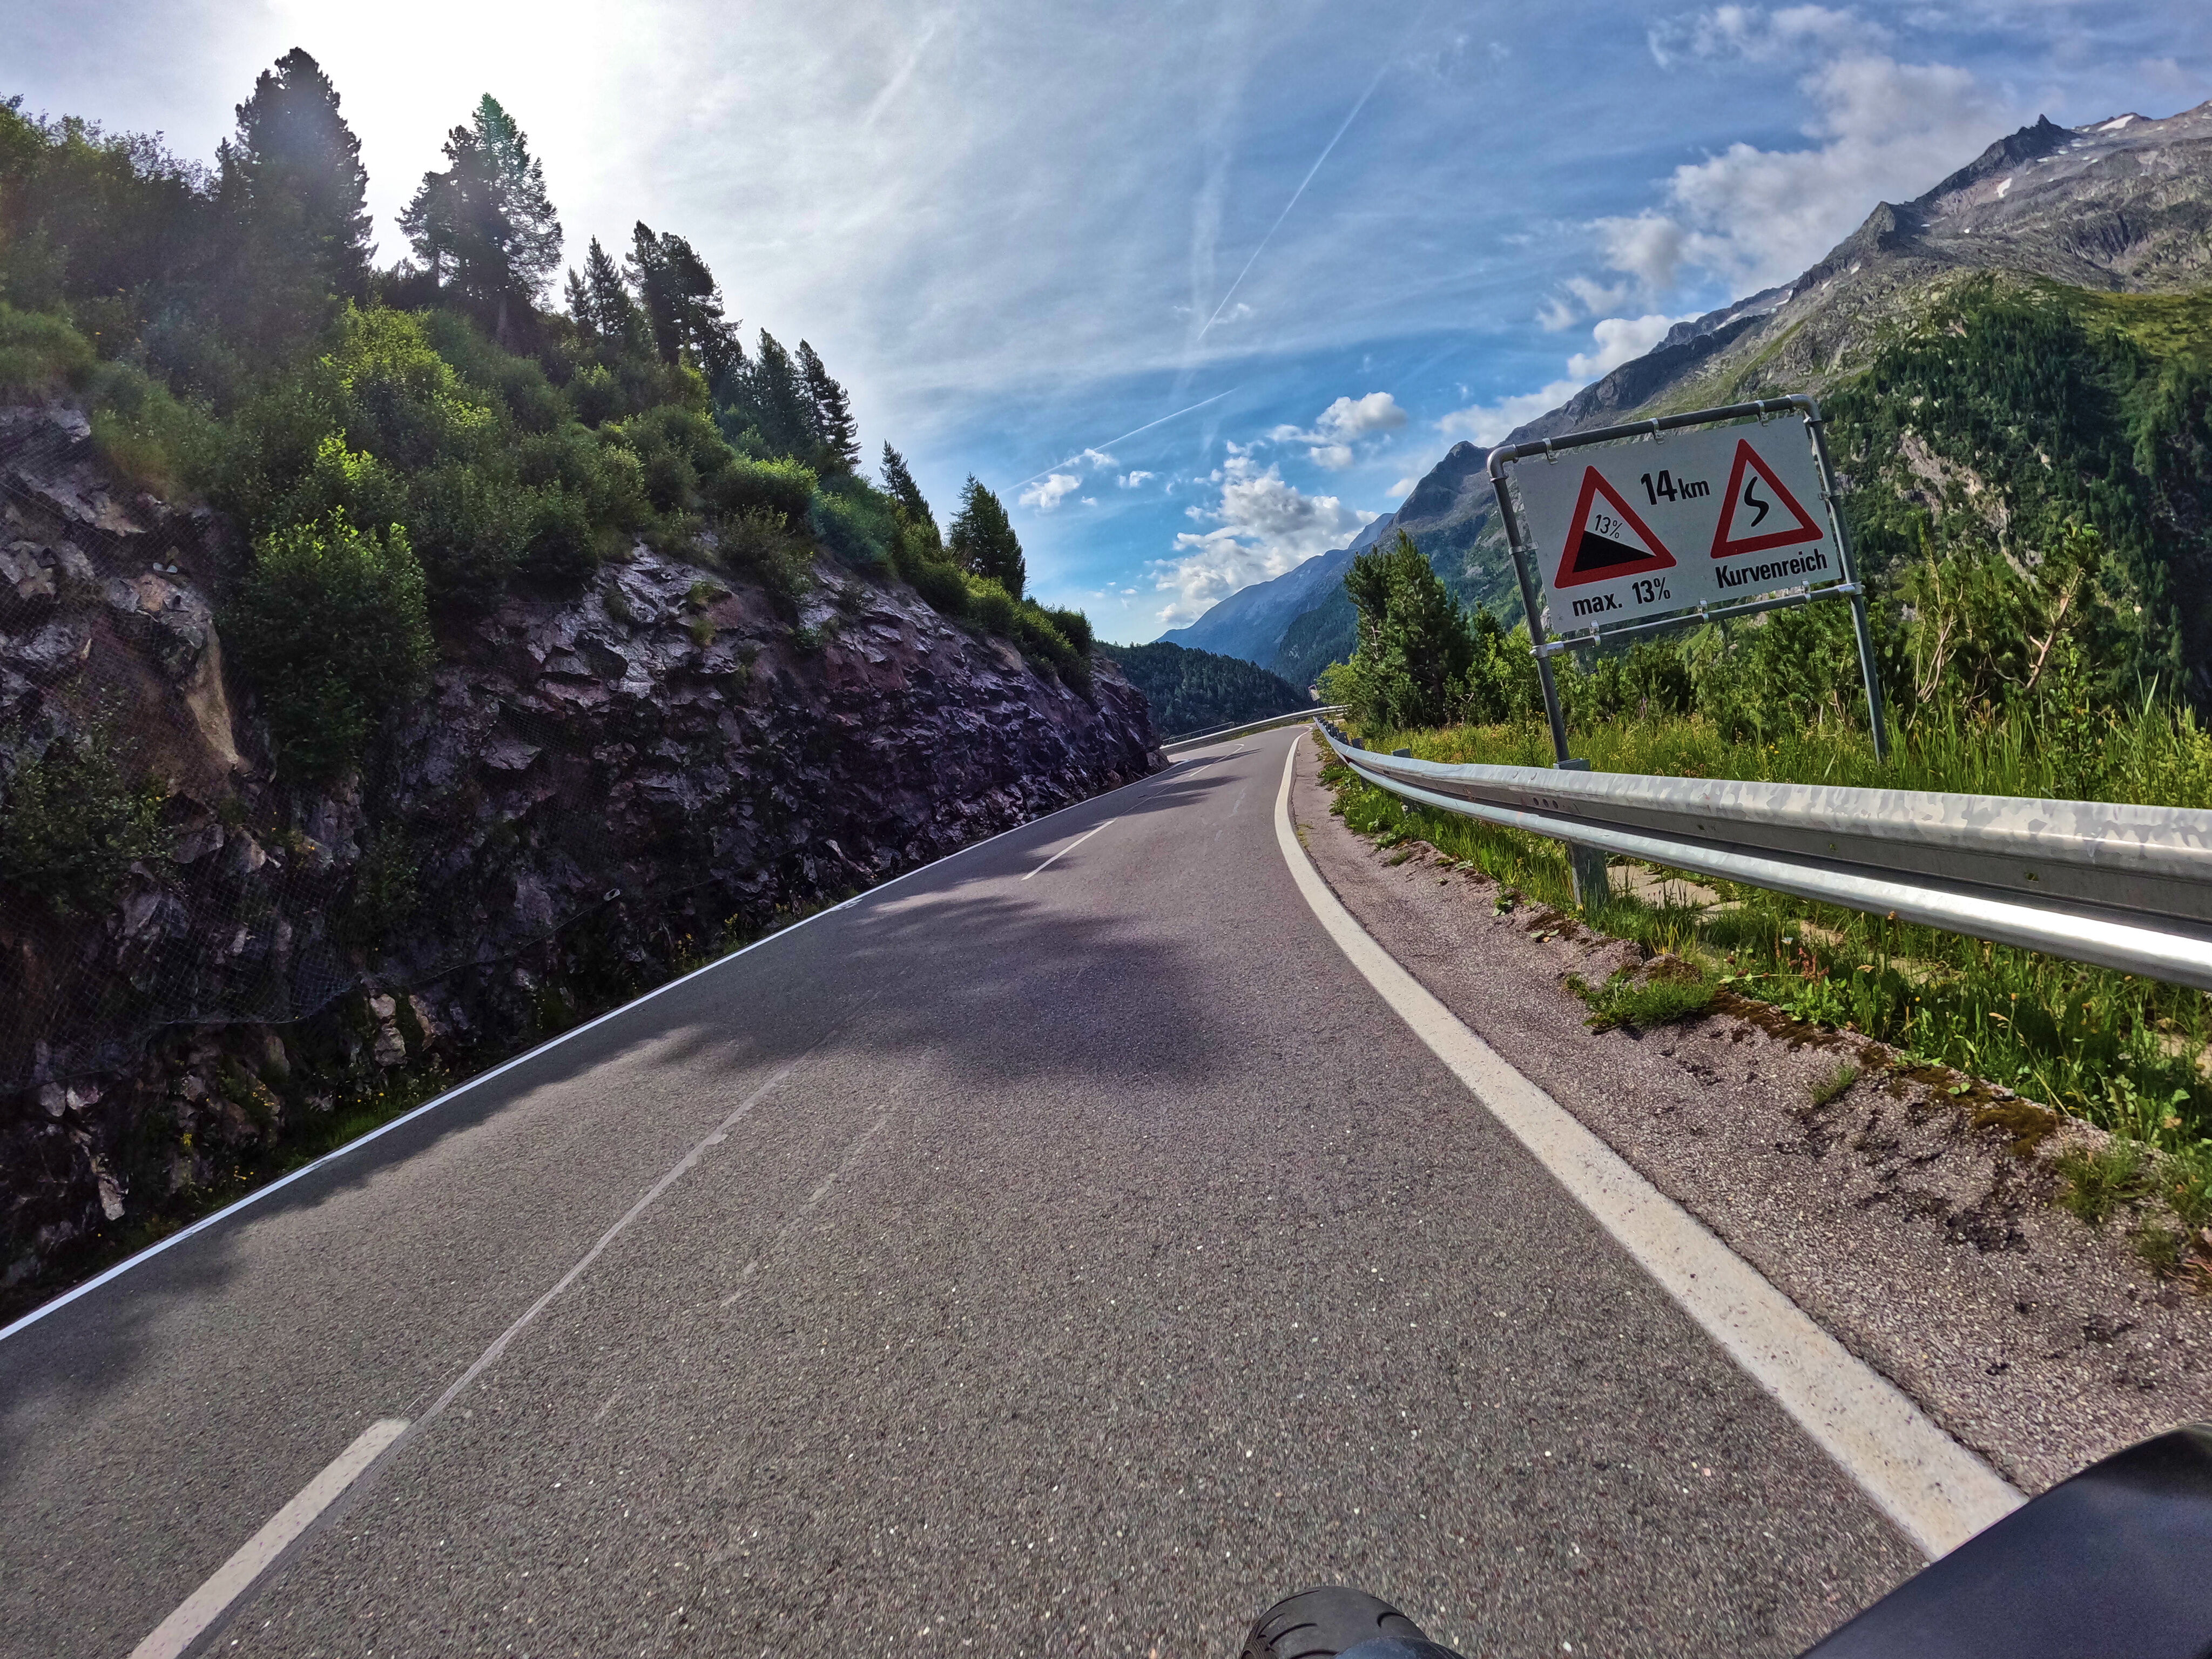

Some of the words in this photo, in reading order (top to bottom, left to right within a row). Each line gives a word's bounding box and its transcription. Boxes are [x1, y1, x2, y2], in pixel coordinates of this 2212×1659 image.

[1641, 469, 1678, 505] 14
[1678, 478, 1711, 500] km
[1594, 514, 1623, 539] 13%
[1715, 548, 1828, 589] Kurvenreich
[1572, 593, 1623, 617] max.
[1631, 577, 1671, 605] 13%
